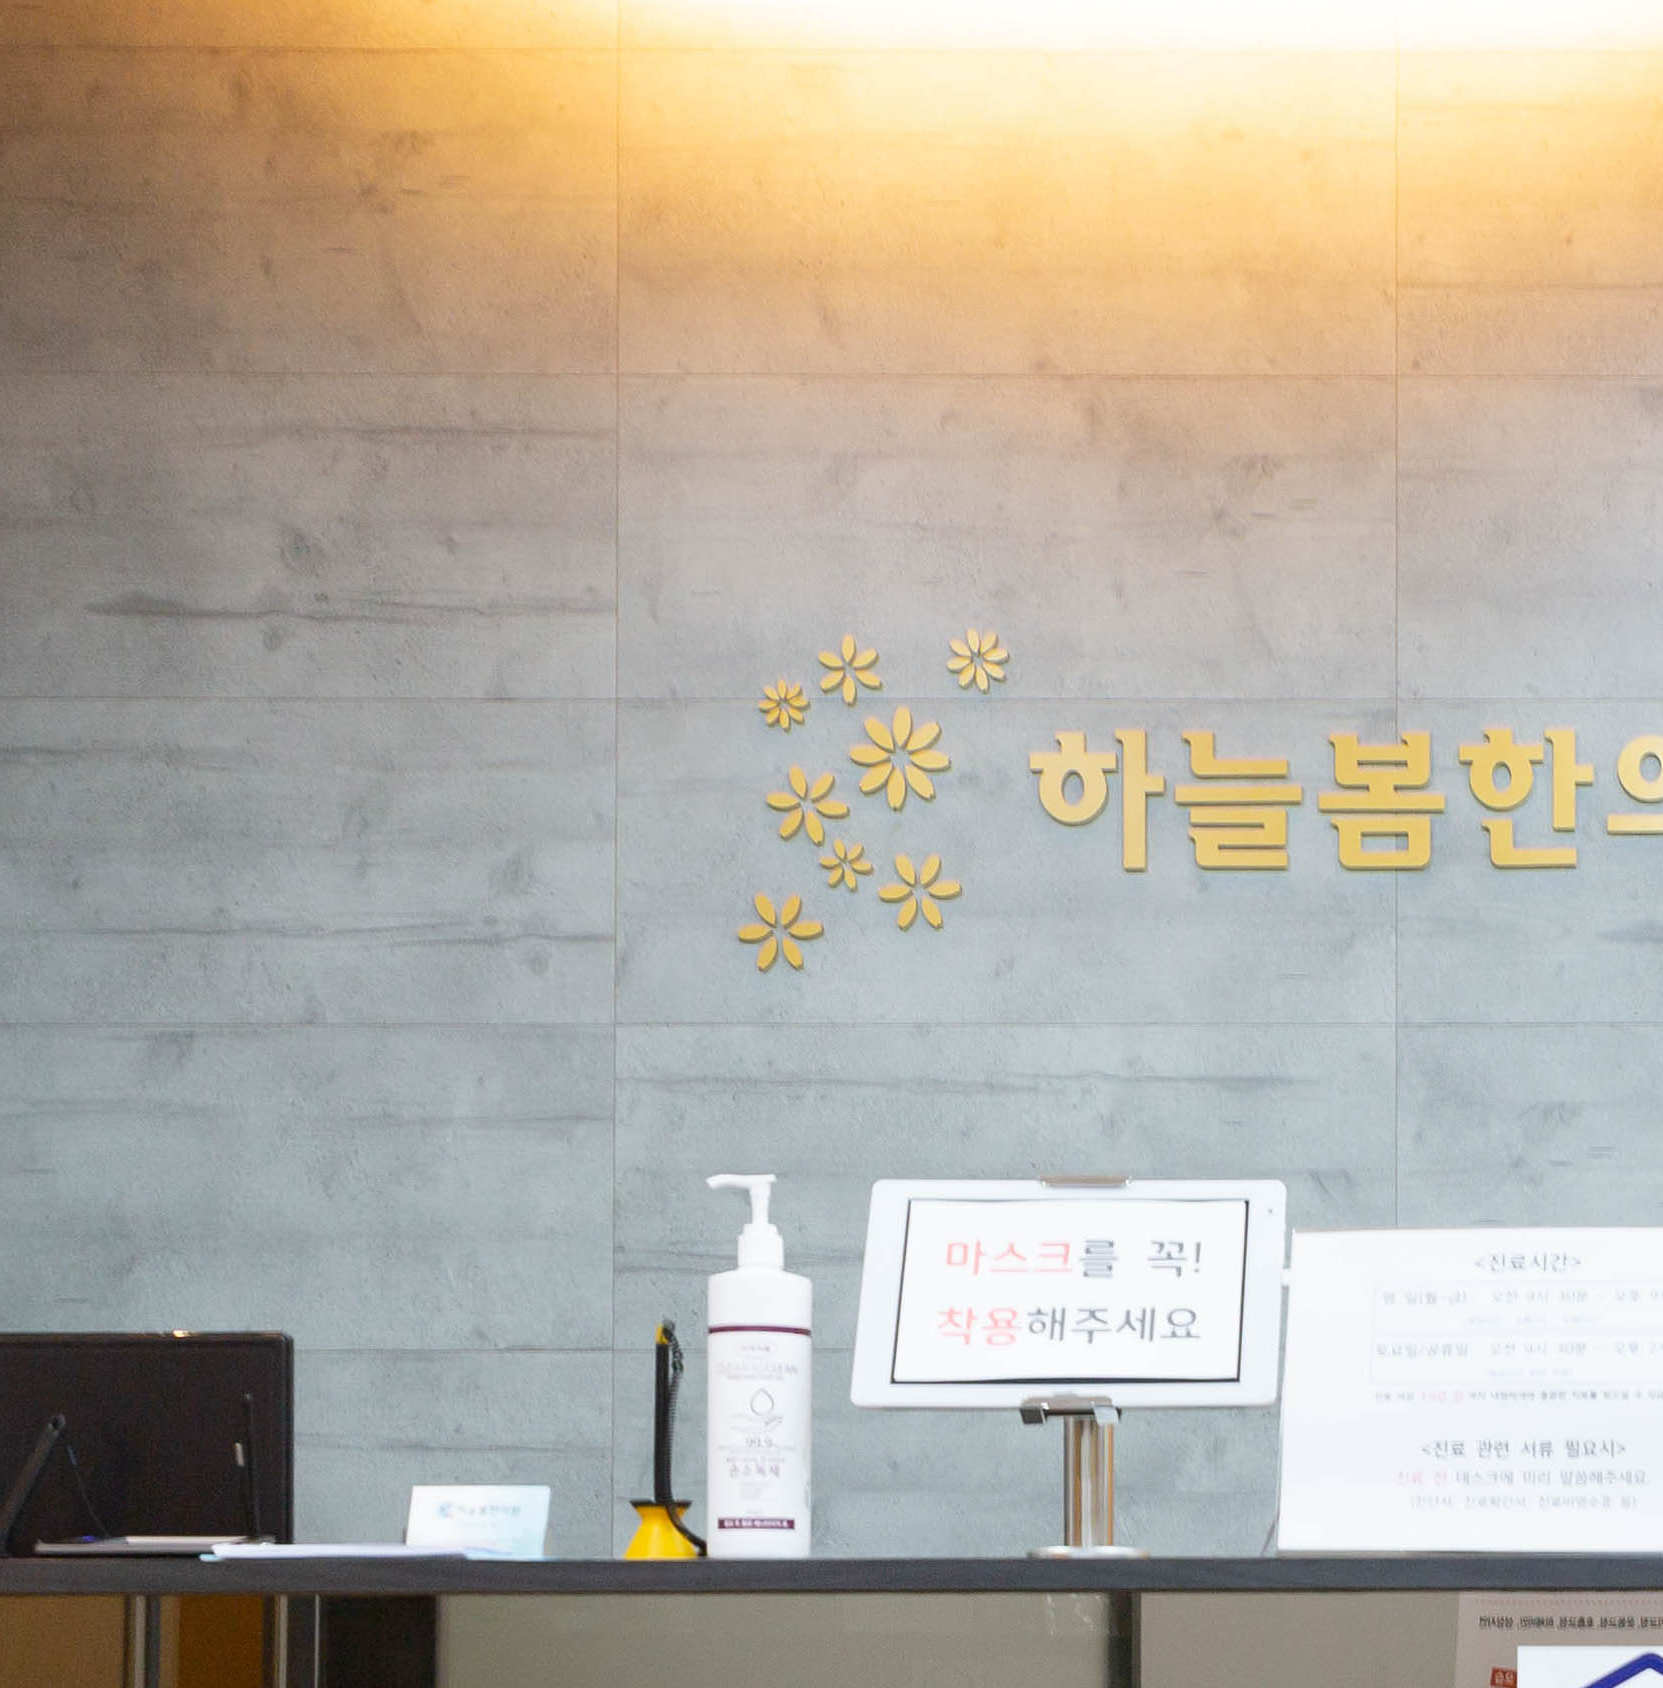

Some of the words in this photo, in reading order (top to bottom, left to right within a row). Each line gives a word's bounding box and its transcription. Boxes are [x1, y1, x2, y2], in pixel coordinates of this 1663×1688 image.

[945, 1237, 1118, 1280] 마스크를
[1146, 1237, 1203, 1278] 꼭!
[937, 1304, 1200, 1346] 착용해주세요
